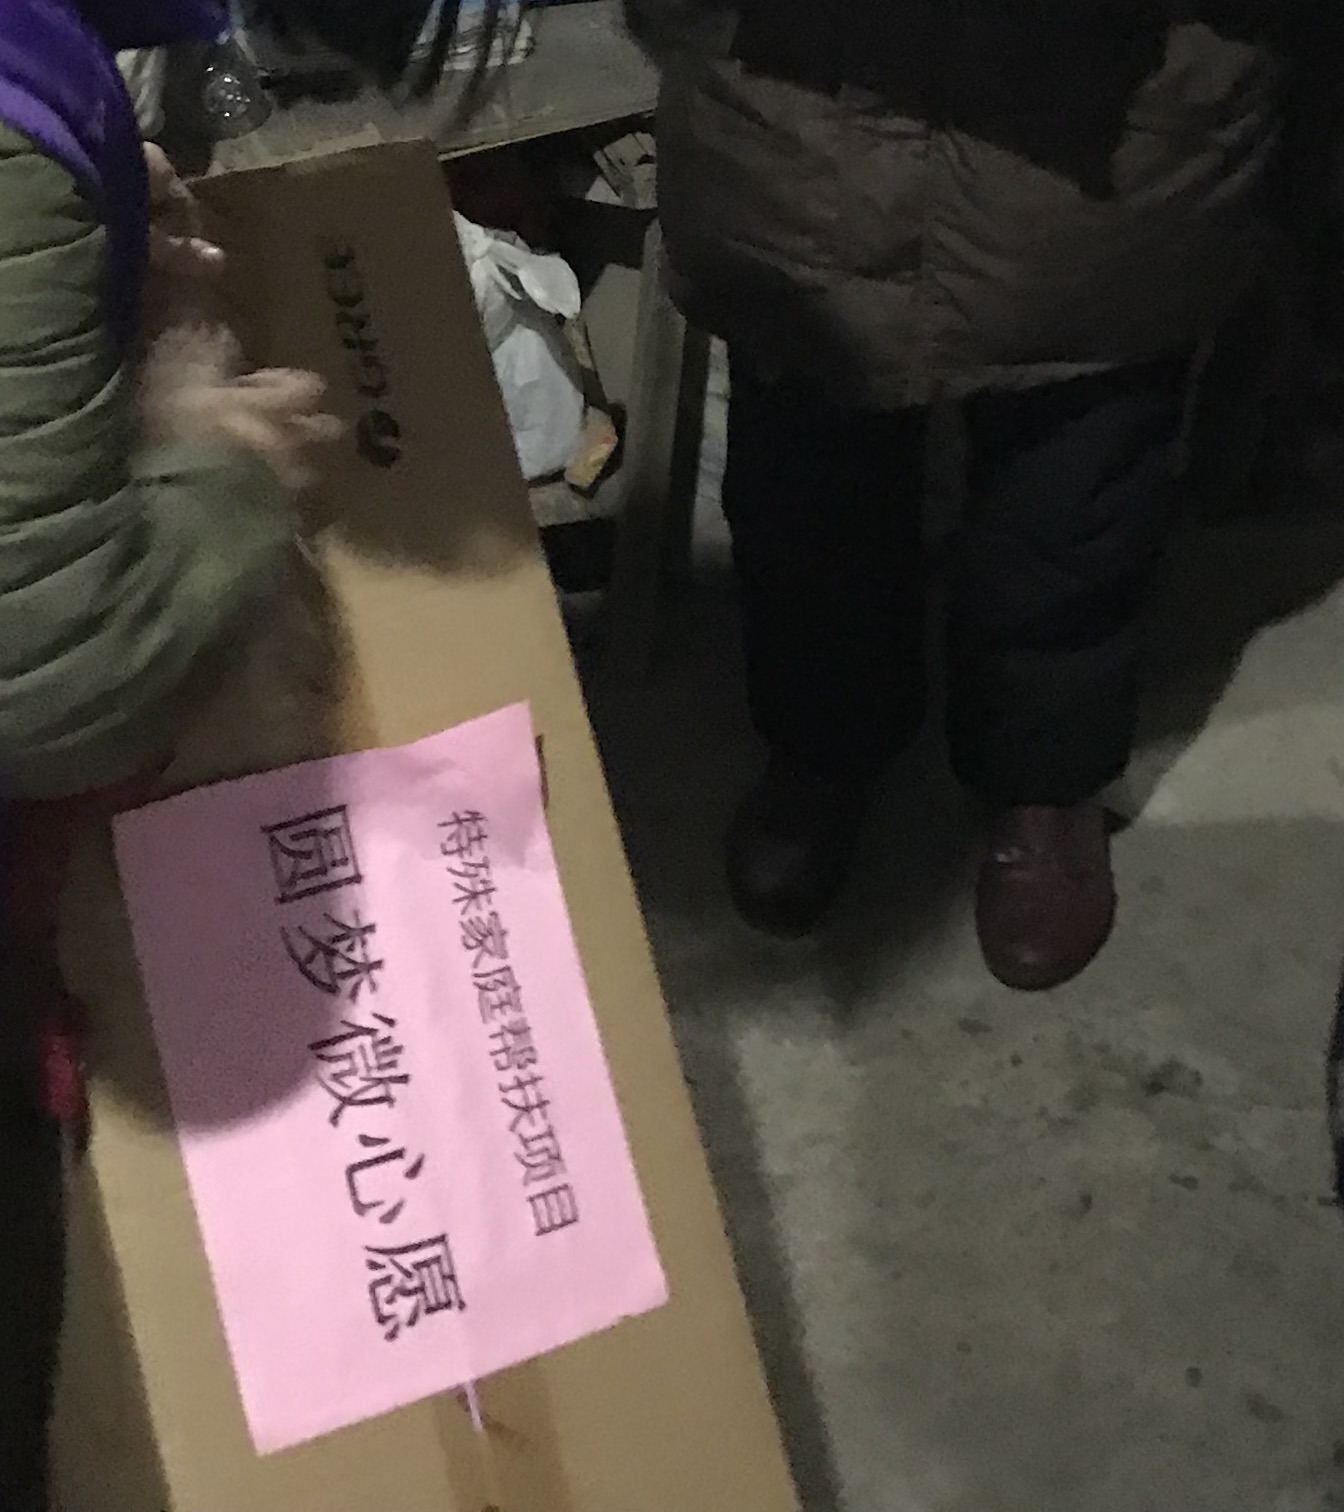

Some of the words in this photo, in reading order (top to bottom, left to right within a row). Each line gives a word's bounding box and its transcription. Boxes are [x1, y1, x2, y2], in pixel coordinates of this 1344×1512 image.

[321, 238, 388, 399] GREE
[260, 804, 466, 1341] 圆梦微心愿
[437, 808, 579, 1236] 特殊家庭帮扶项目
